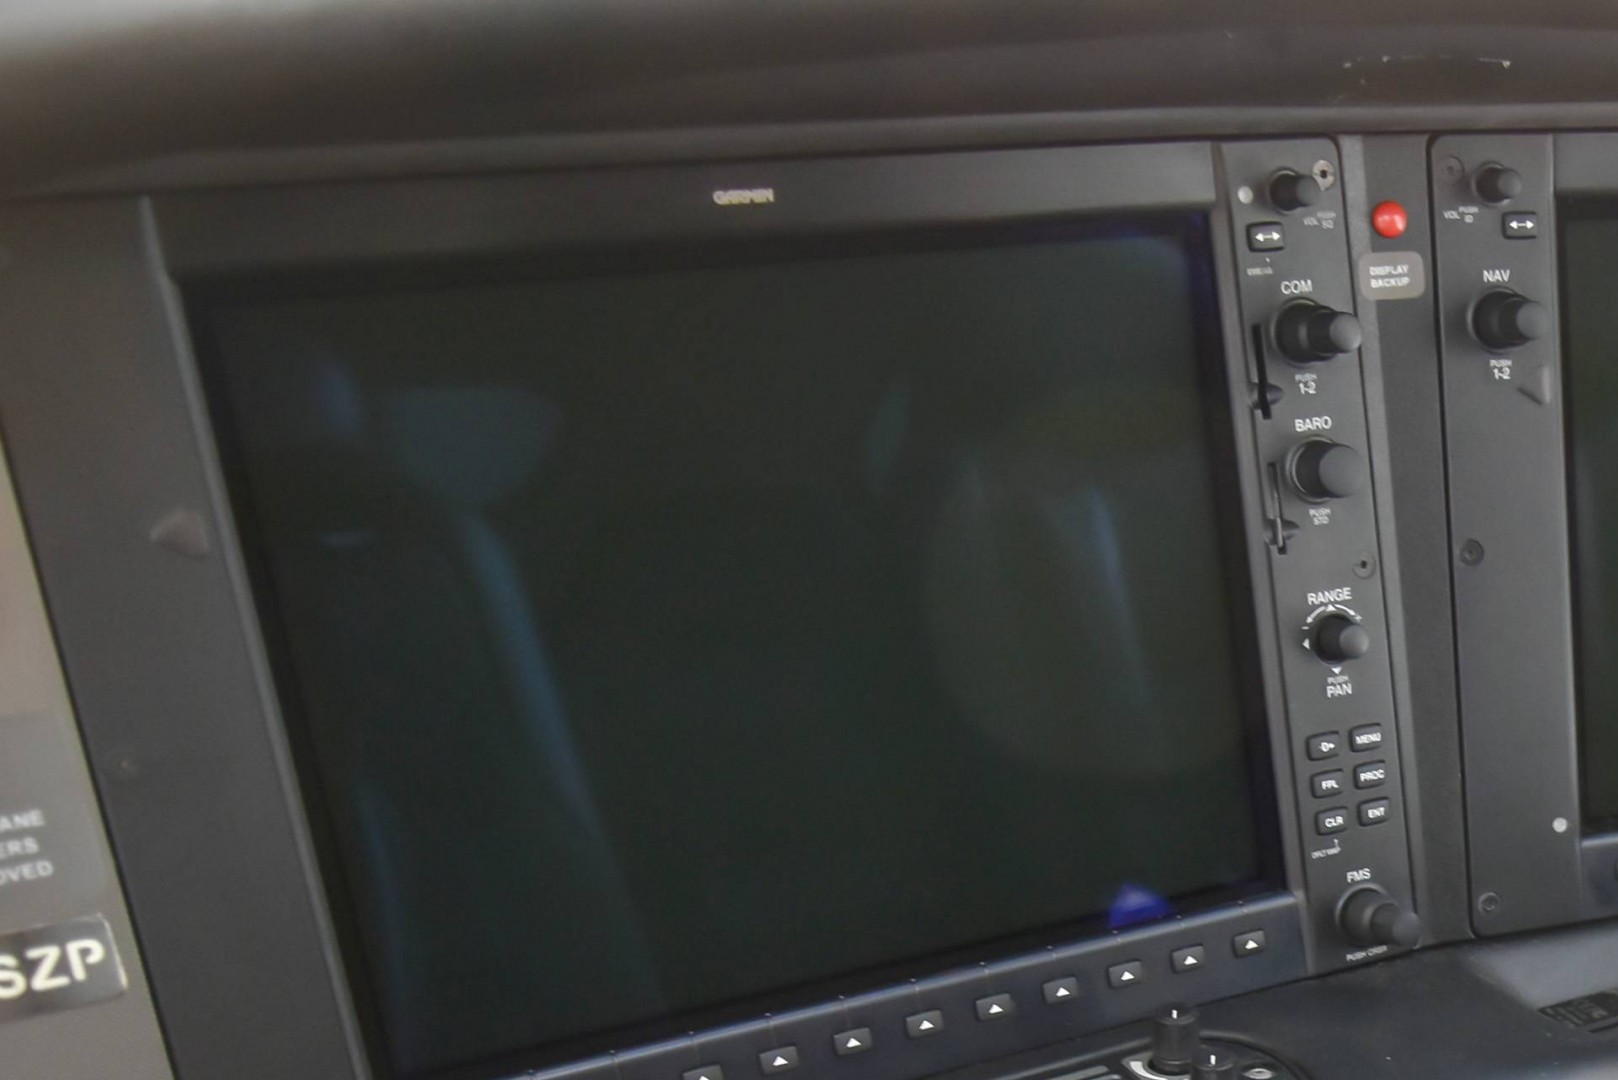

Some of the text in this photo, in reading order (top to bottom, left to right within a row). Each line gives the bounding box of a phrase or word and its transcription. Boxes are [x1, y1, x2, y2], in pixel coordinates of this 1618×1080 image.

[1369, 264, 1410, 276] DISPLAY
[1483, 269, 1510, 282] NAV
[1281, 280, 1312, 294] COM
[1370, 276, 1410, 288] BACKUP
[1295, 416, 1332, 432] BARO
[1307, 588, 1352, 606] RANGE
[1326, 683, 1352, 698] PAN
[1354, 732, 1382, 744] MENU
[1360, 769, 1384, 782] PROC
[1368, 807, 1386, 818] ENT
[1324, 816, 1344, 828] CLR
[0, 860, 54, 885] VED
[1346, 868, 1371, 883] FMS
[0, 937, 105, 999] SZP
